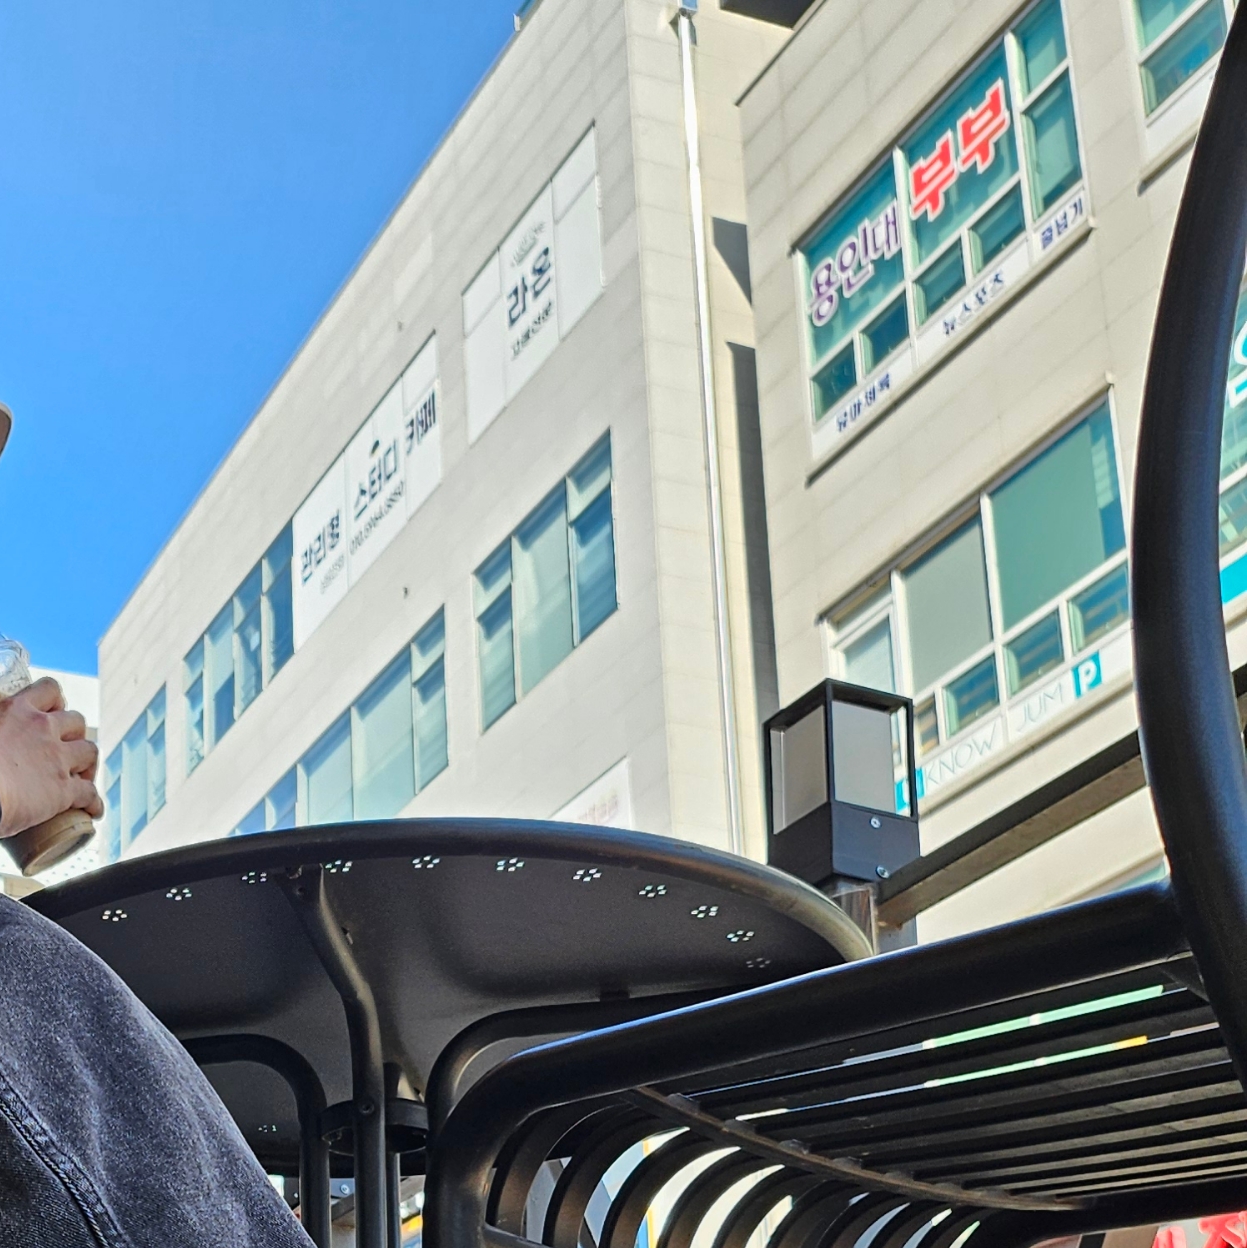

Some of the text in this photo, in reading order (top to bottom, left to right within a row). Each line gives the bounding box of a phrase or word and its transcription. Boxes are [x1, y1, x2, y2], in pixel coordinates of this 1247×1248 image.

[810, 78, 1011, 327] 용인대 부부
[1040, 197, 1083, 250] 줄넘기
[507, 246, 551, 328] 라온
[301, 508, 340, 586] 관리형
[354, 438, 400, 522] 스터디
[405, 385, 437, 457] 카페
